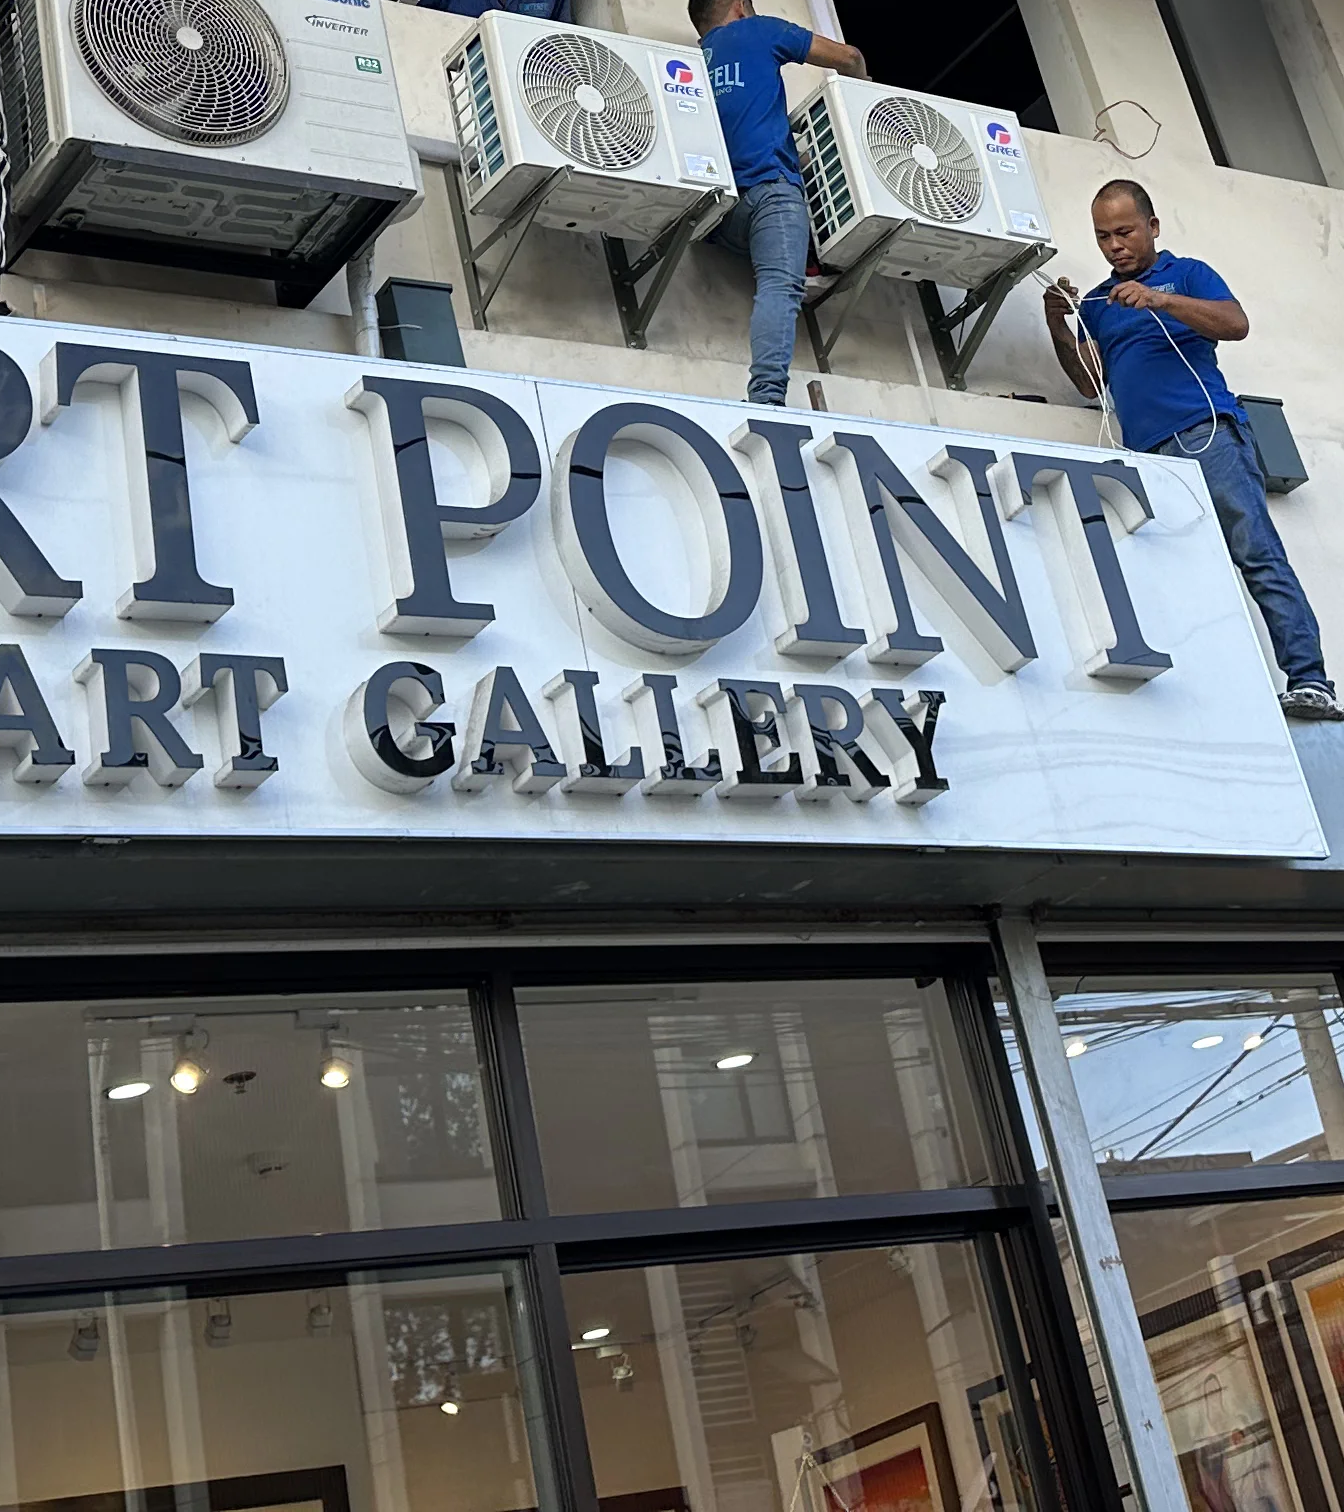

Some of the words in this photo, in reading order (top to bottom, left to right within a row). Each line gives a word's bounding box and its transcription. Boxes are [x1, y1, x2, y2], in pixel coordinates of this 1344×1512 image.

[311, 19, 369, 37] INVERTER
[357, 57, 379, 69] R32
[663, 82, 705, 99] GREE
[986, 143, 1022, 159] GREE
[346, 375, 1174, 682] POINT
[346, 660, 949, 806] GALLERY
